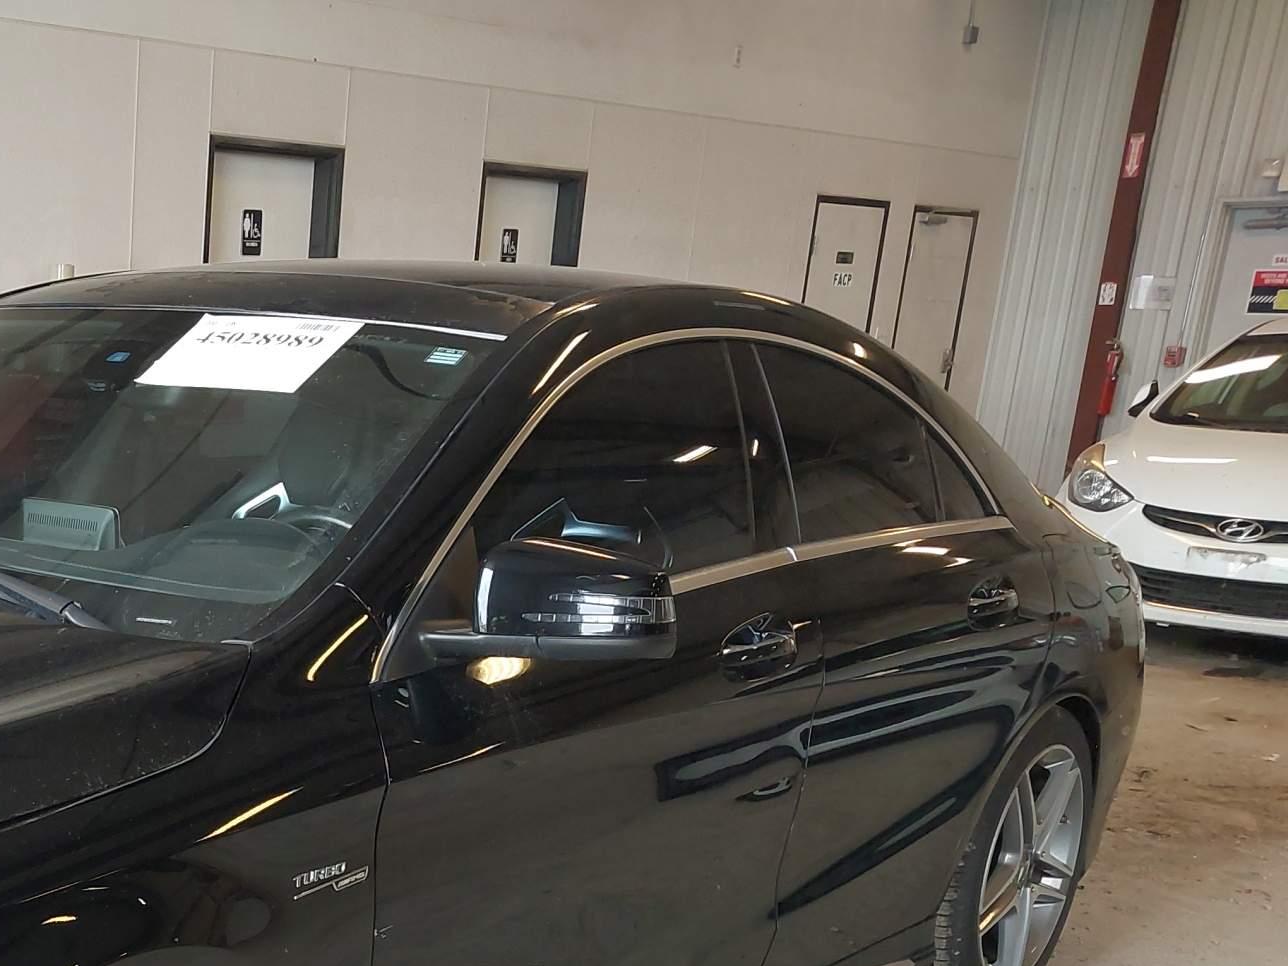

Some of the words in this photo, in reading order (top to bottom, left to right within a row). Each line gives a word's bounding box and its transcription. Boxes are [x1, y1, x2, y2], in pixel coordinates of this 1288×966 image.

[832, 272, 853, 287] FACP
[196, 331, 325, 348] 45028989
[292, 861, 347, 888] TURBO
